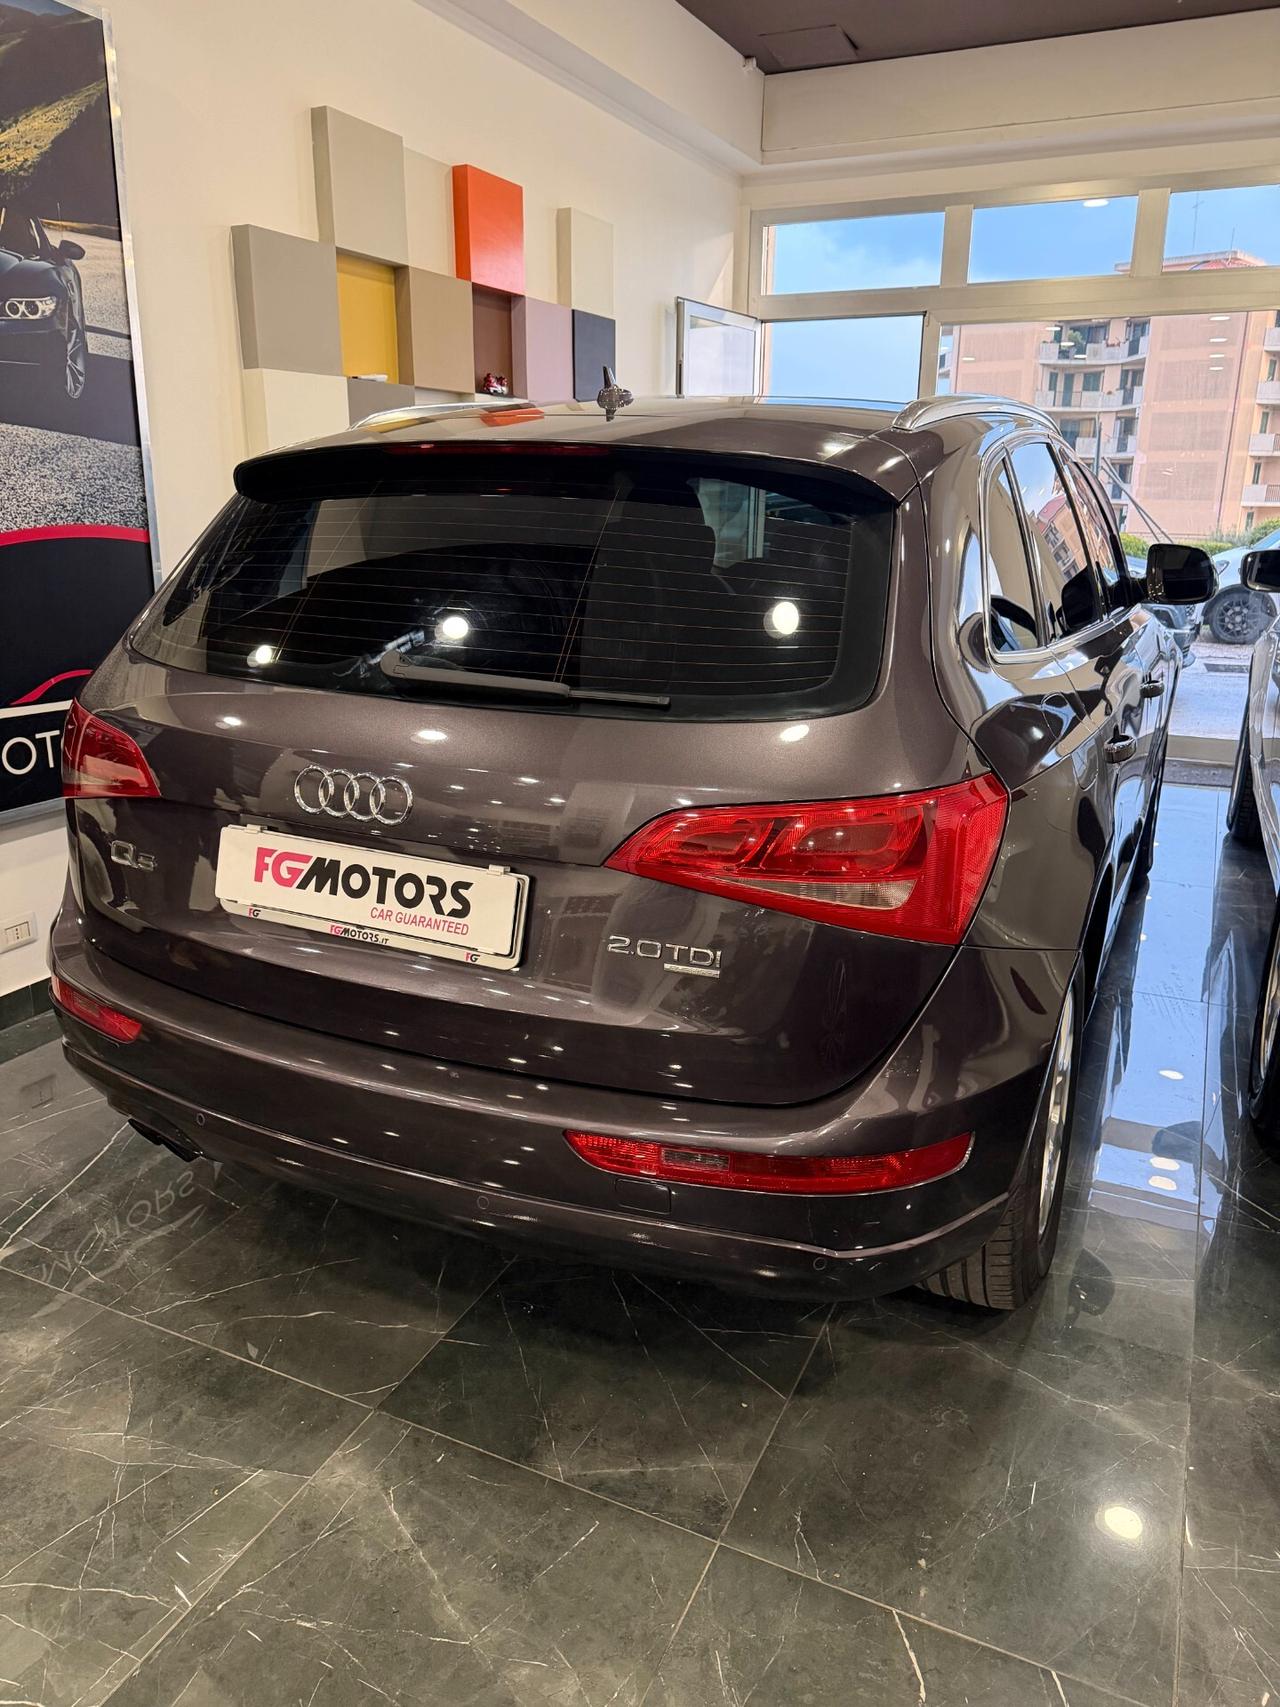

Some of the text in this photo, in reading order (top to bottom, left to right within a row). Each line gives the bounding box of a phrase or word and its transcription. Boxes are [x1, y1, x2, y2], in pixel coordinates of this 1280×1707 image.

[1, 729, 64, 775] OT
[110, 840, 155, 871] Q5
[248, 907, 262, 918] FG
[370, 907, 469, 936] CAR GUARANTEED
[465, 952, 481, 963] FG
